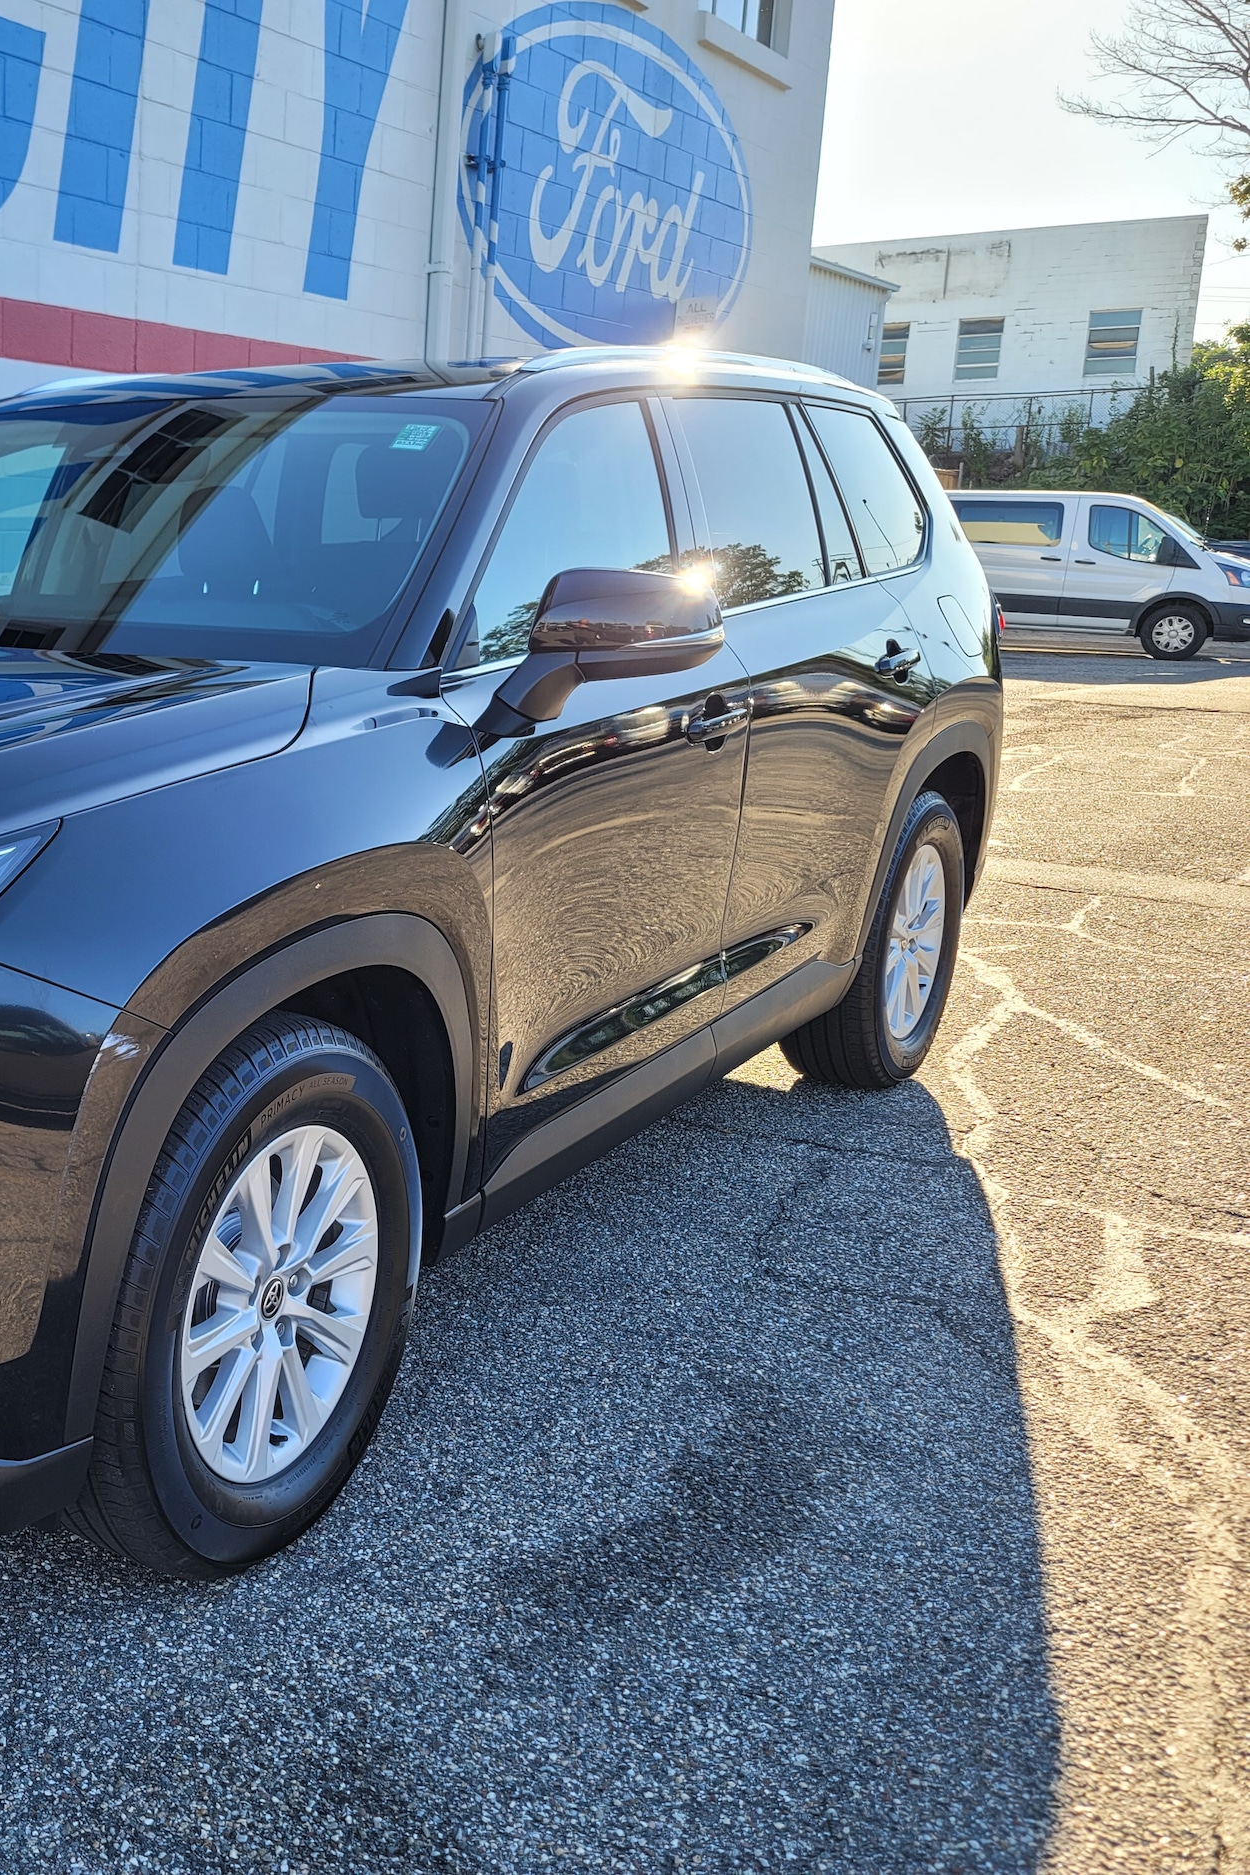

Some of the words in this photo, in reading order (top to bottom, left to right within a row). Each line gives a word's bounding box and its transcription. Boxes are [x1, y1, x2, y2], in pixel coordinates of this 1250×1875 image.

[529, 60, 705, 303] Ford
[686, 303, 707, 314] ALL
[187, 1136, 249, 1261] MICHELIN
[260, 1085, 305, 1127] PRIMACY
[308, 1079, 321, 1089] ALL
[322, 1077, 349, 1087] SEASON
